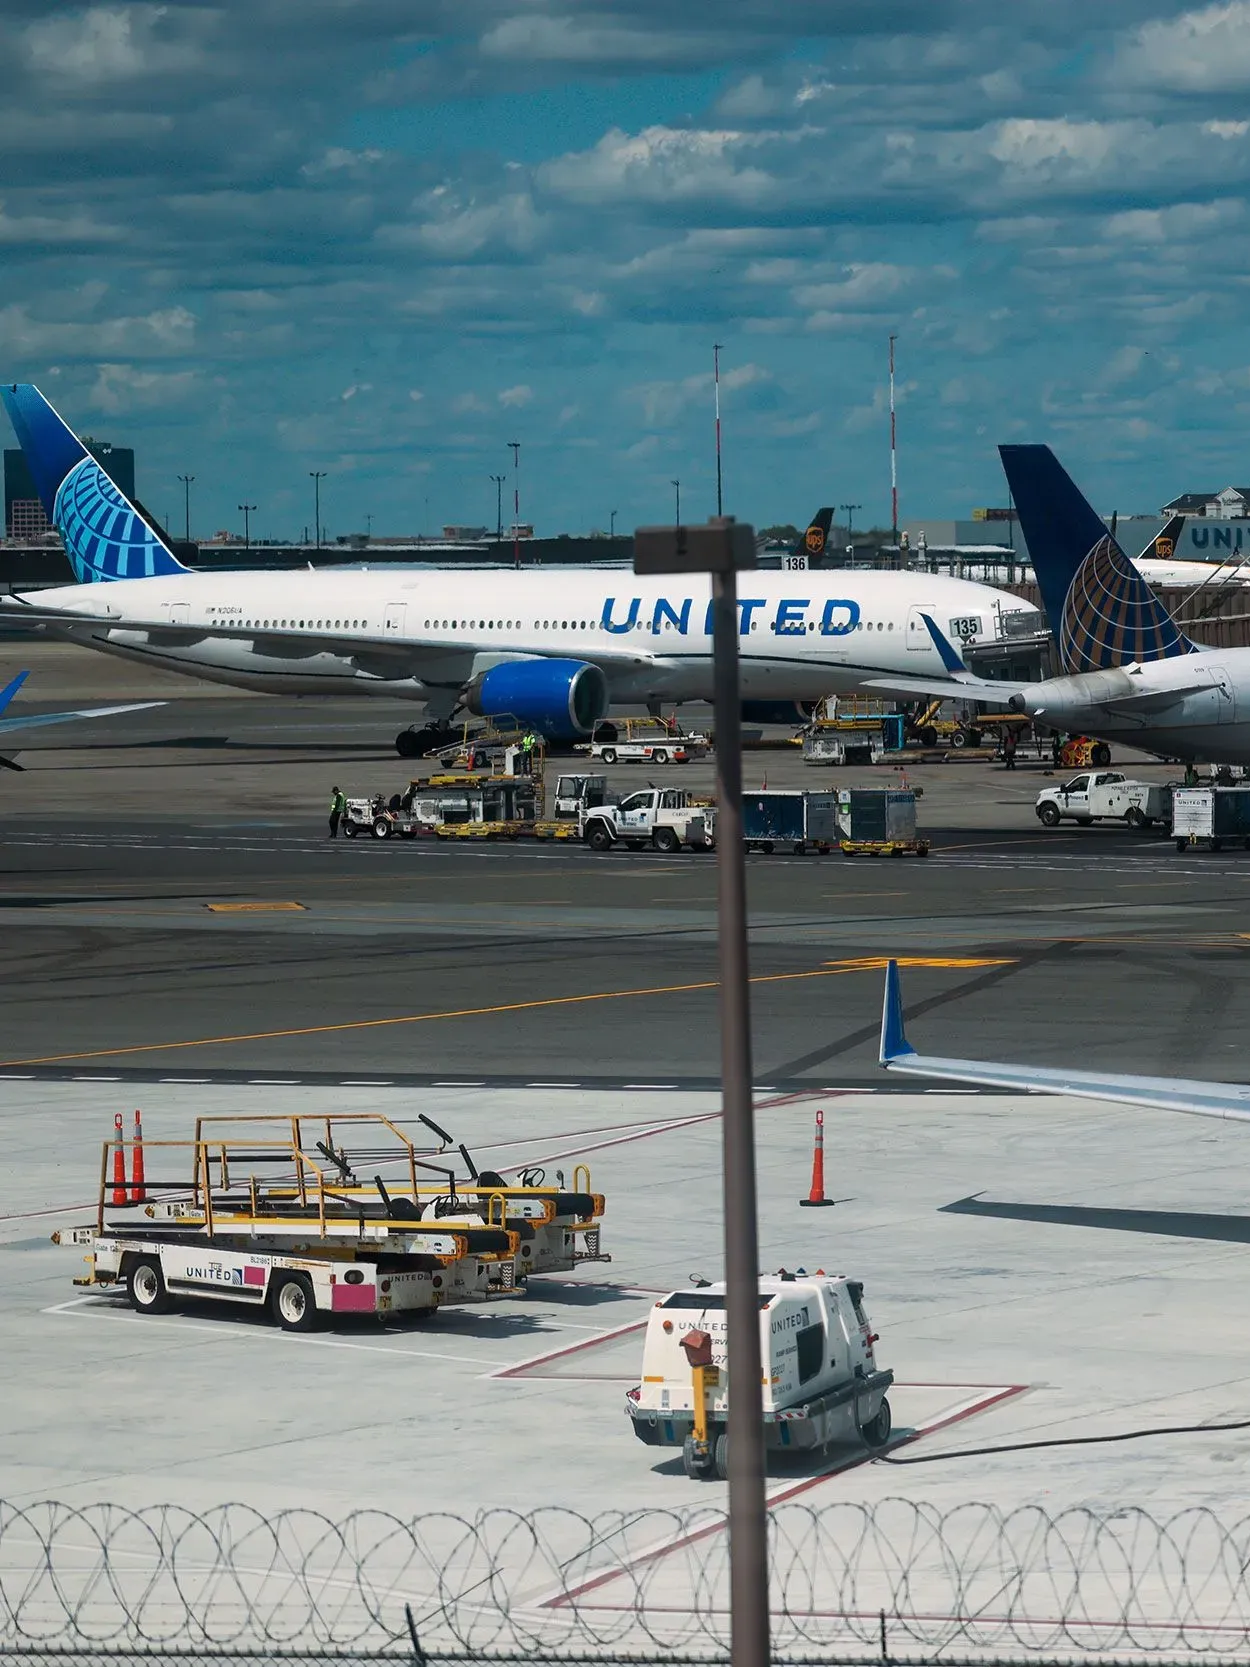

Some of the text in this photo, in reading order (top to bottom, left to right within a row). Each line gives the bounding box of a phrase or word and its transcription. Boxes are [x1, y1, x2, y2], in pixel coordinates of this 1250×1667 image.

[786, 558, 805, 570] 136
[600, 597, 861, 636] UNITED
[953, 618, 978, 635] 135
[186, 1267, 231, 1281] UNITED
[388, 1273, 424, 1283] UNITED
[679, 1322, 728, 1331] UNITED
[771, 1313, 802, 1335] UNITED
